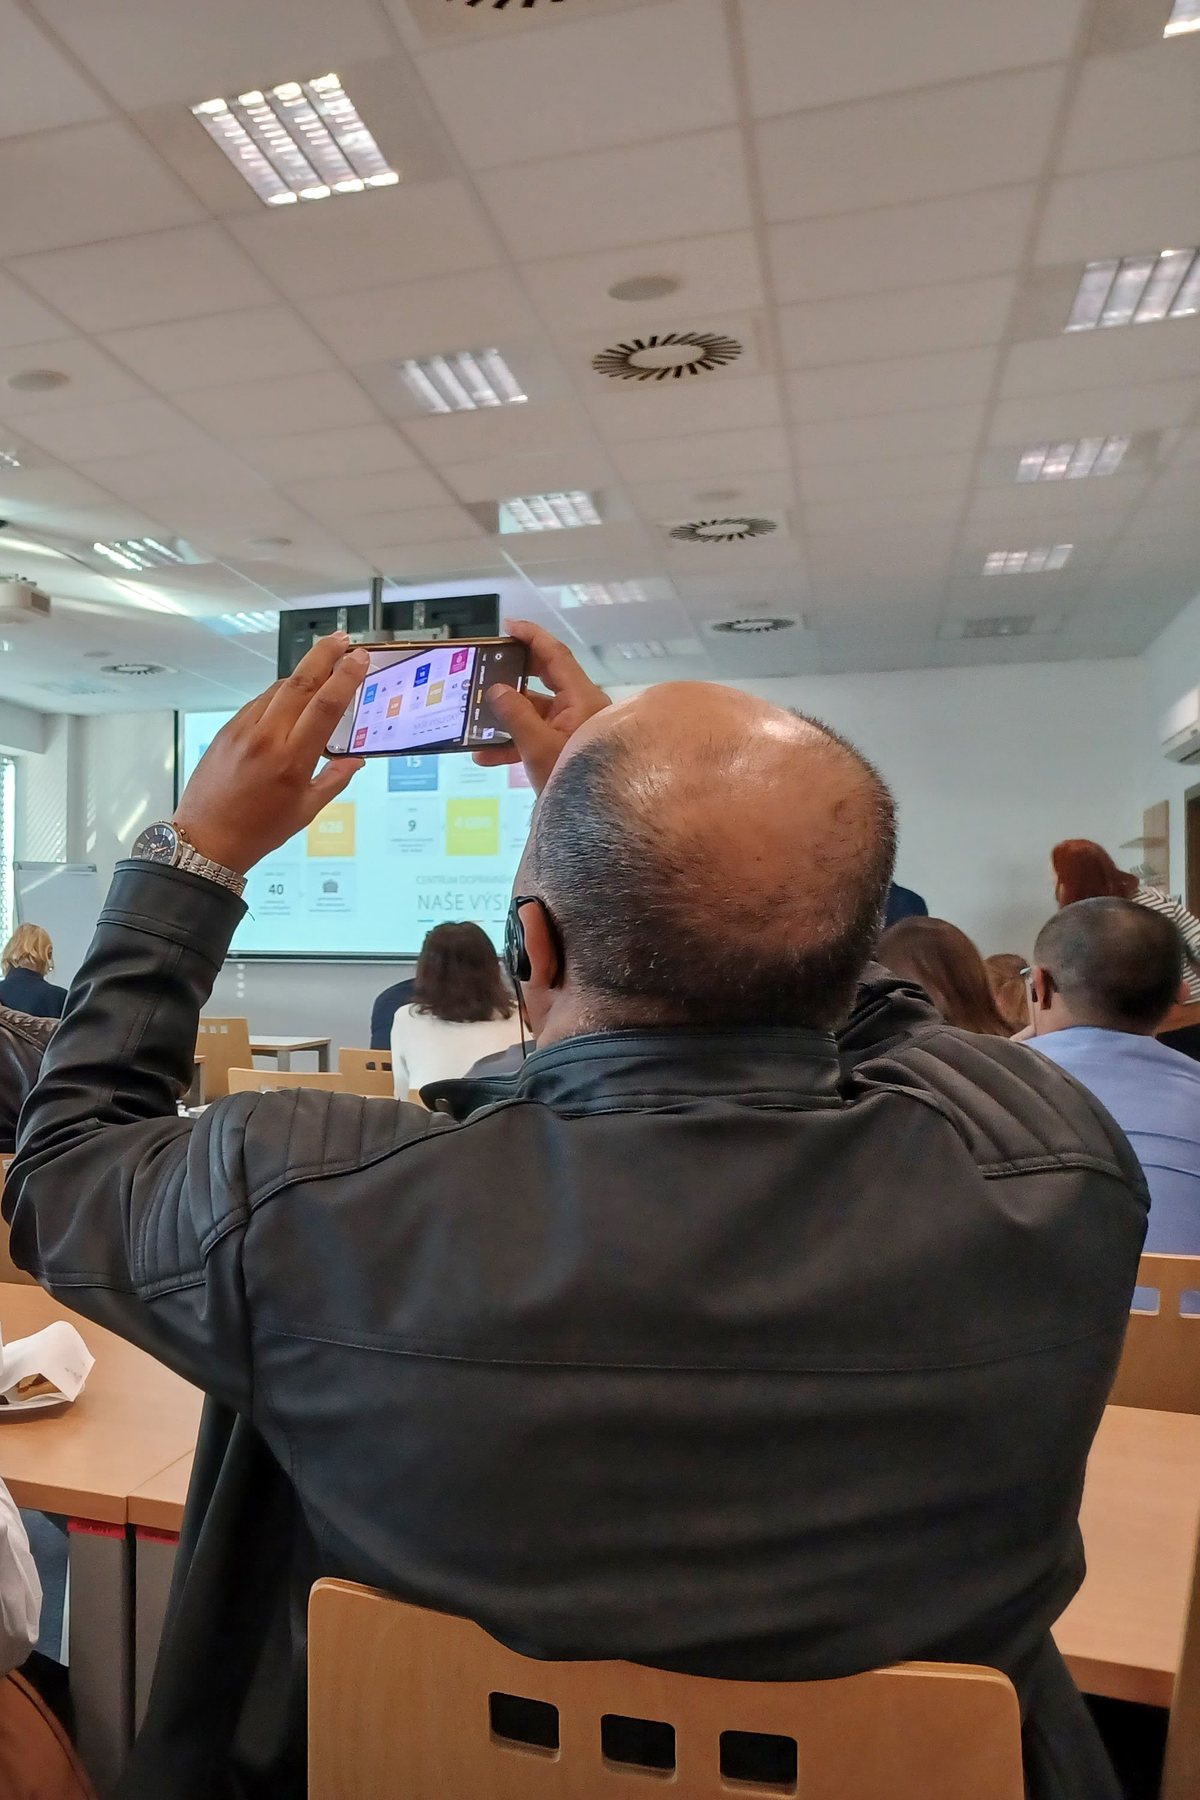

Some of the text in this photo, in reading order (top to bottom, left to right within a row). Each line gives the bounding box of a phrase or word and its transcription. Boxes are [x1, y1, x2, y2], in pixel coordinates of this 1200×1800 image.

[408, 820, 416, 832] 9
[268, 884, 284, 895] 40
[417, 891, 465, 911] NAŠE
